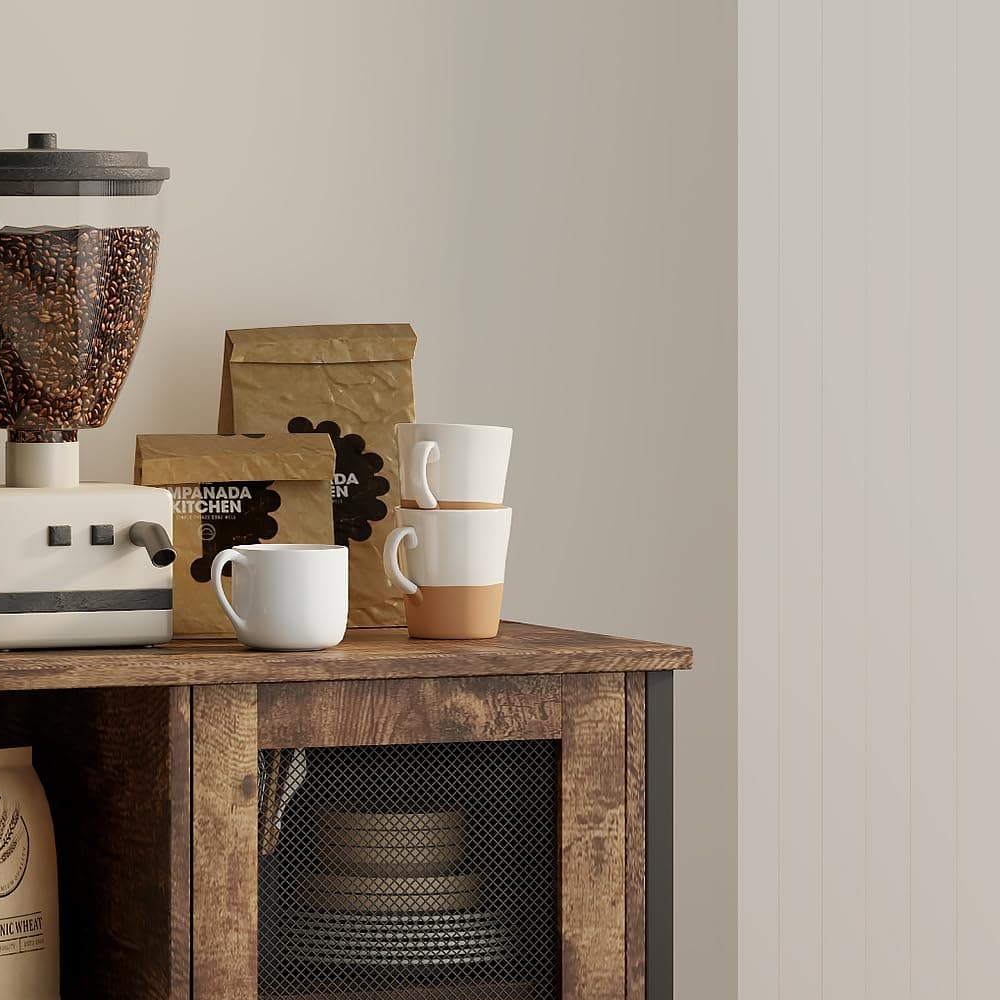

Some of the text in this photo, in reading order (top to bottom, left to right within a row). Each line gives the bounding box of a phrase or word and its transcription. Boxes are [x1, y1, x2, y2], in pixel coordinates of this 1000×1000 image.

[167, 486, 252, 499] MPANADA
[173, 500, 242, 513] KITCHEN
[14, 917, 43, 935] WHEAT
